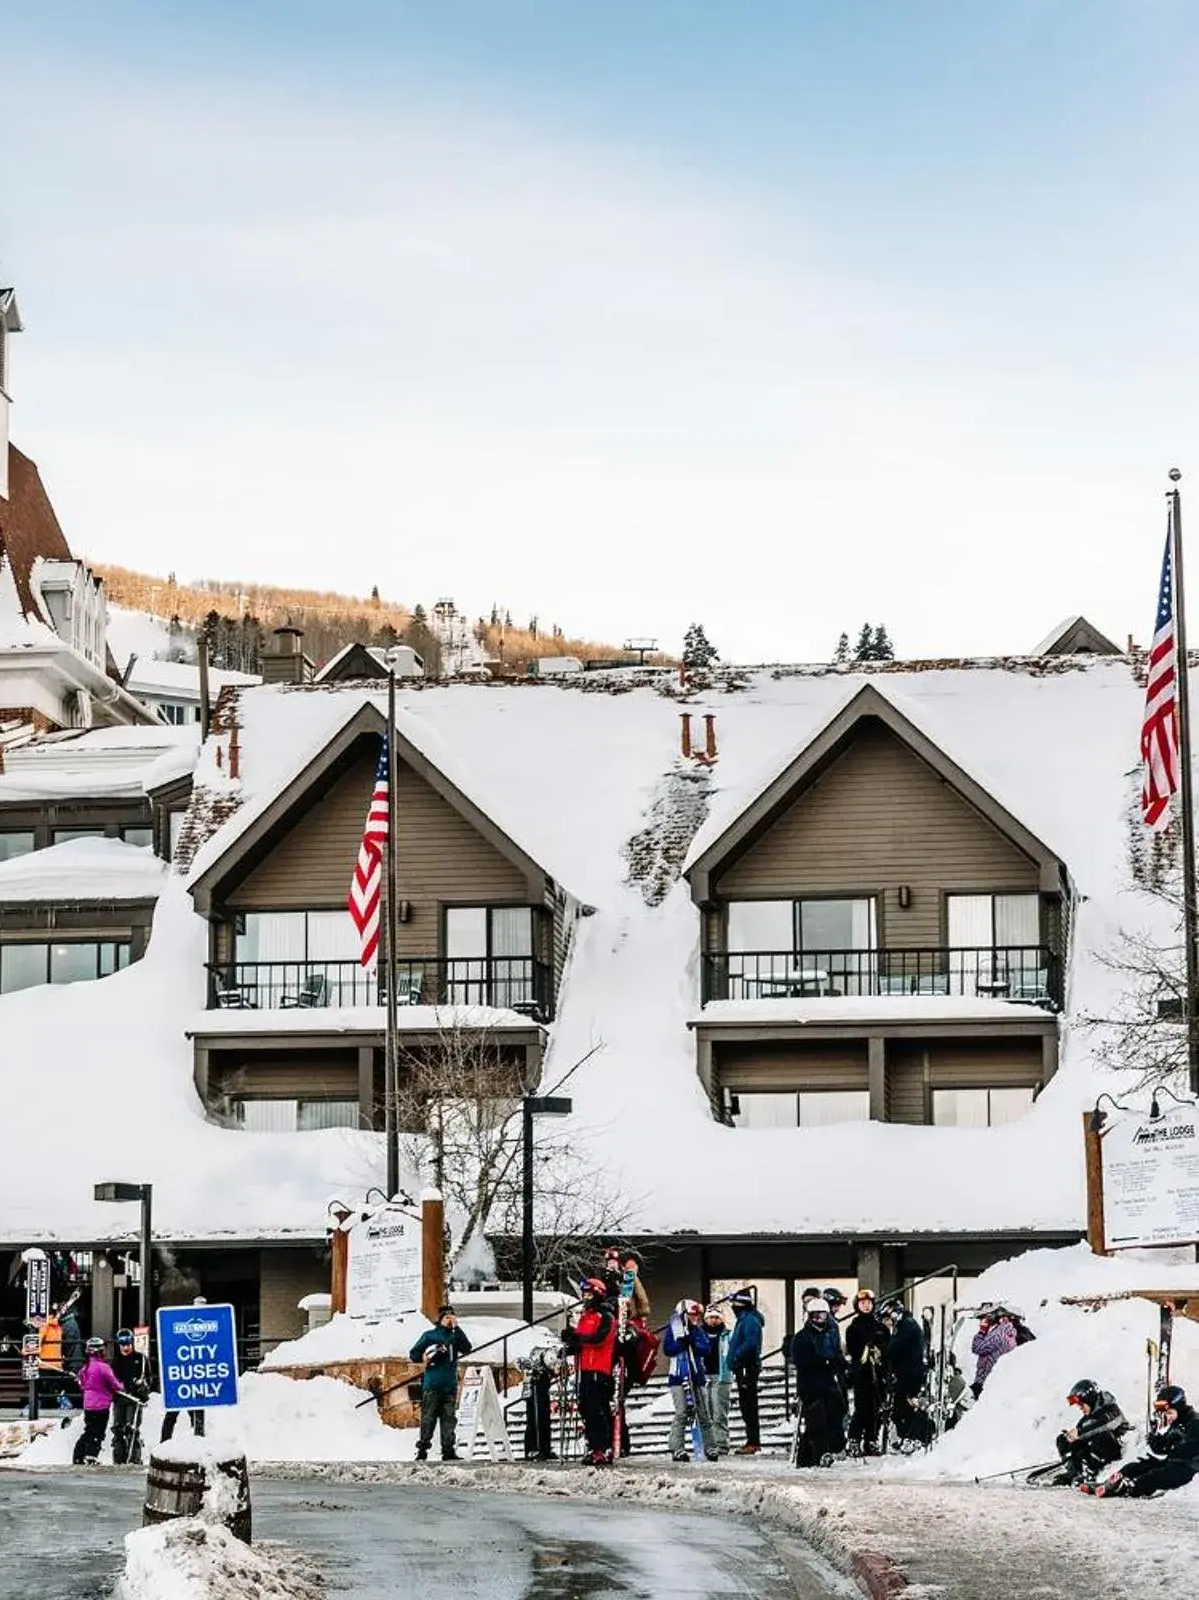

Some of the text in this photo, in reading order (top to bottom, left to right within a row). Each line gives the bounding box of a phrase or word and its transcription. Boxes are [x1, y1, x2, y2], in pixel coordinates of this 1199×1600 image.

[177, 1344, 218, 1361] CITY
[168, 1362, 230, 1380] BUSES
[177, 1382, 222, 1400] ONLY
